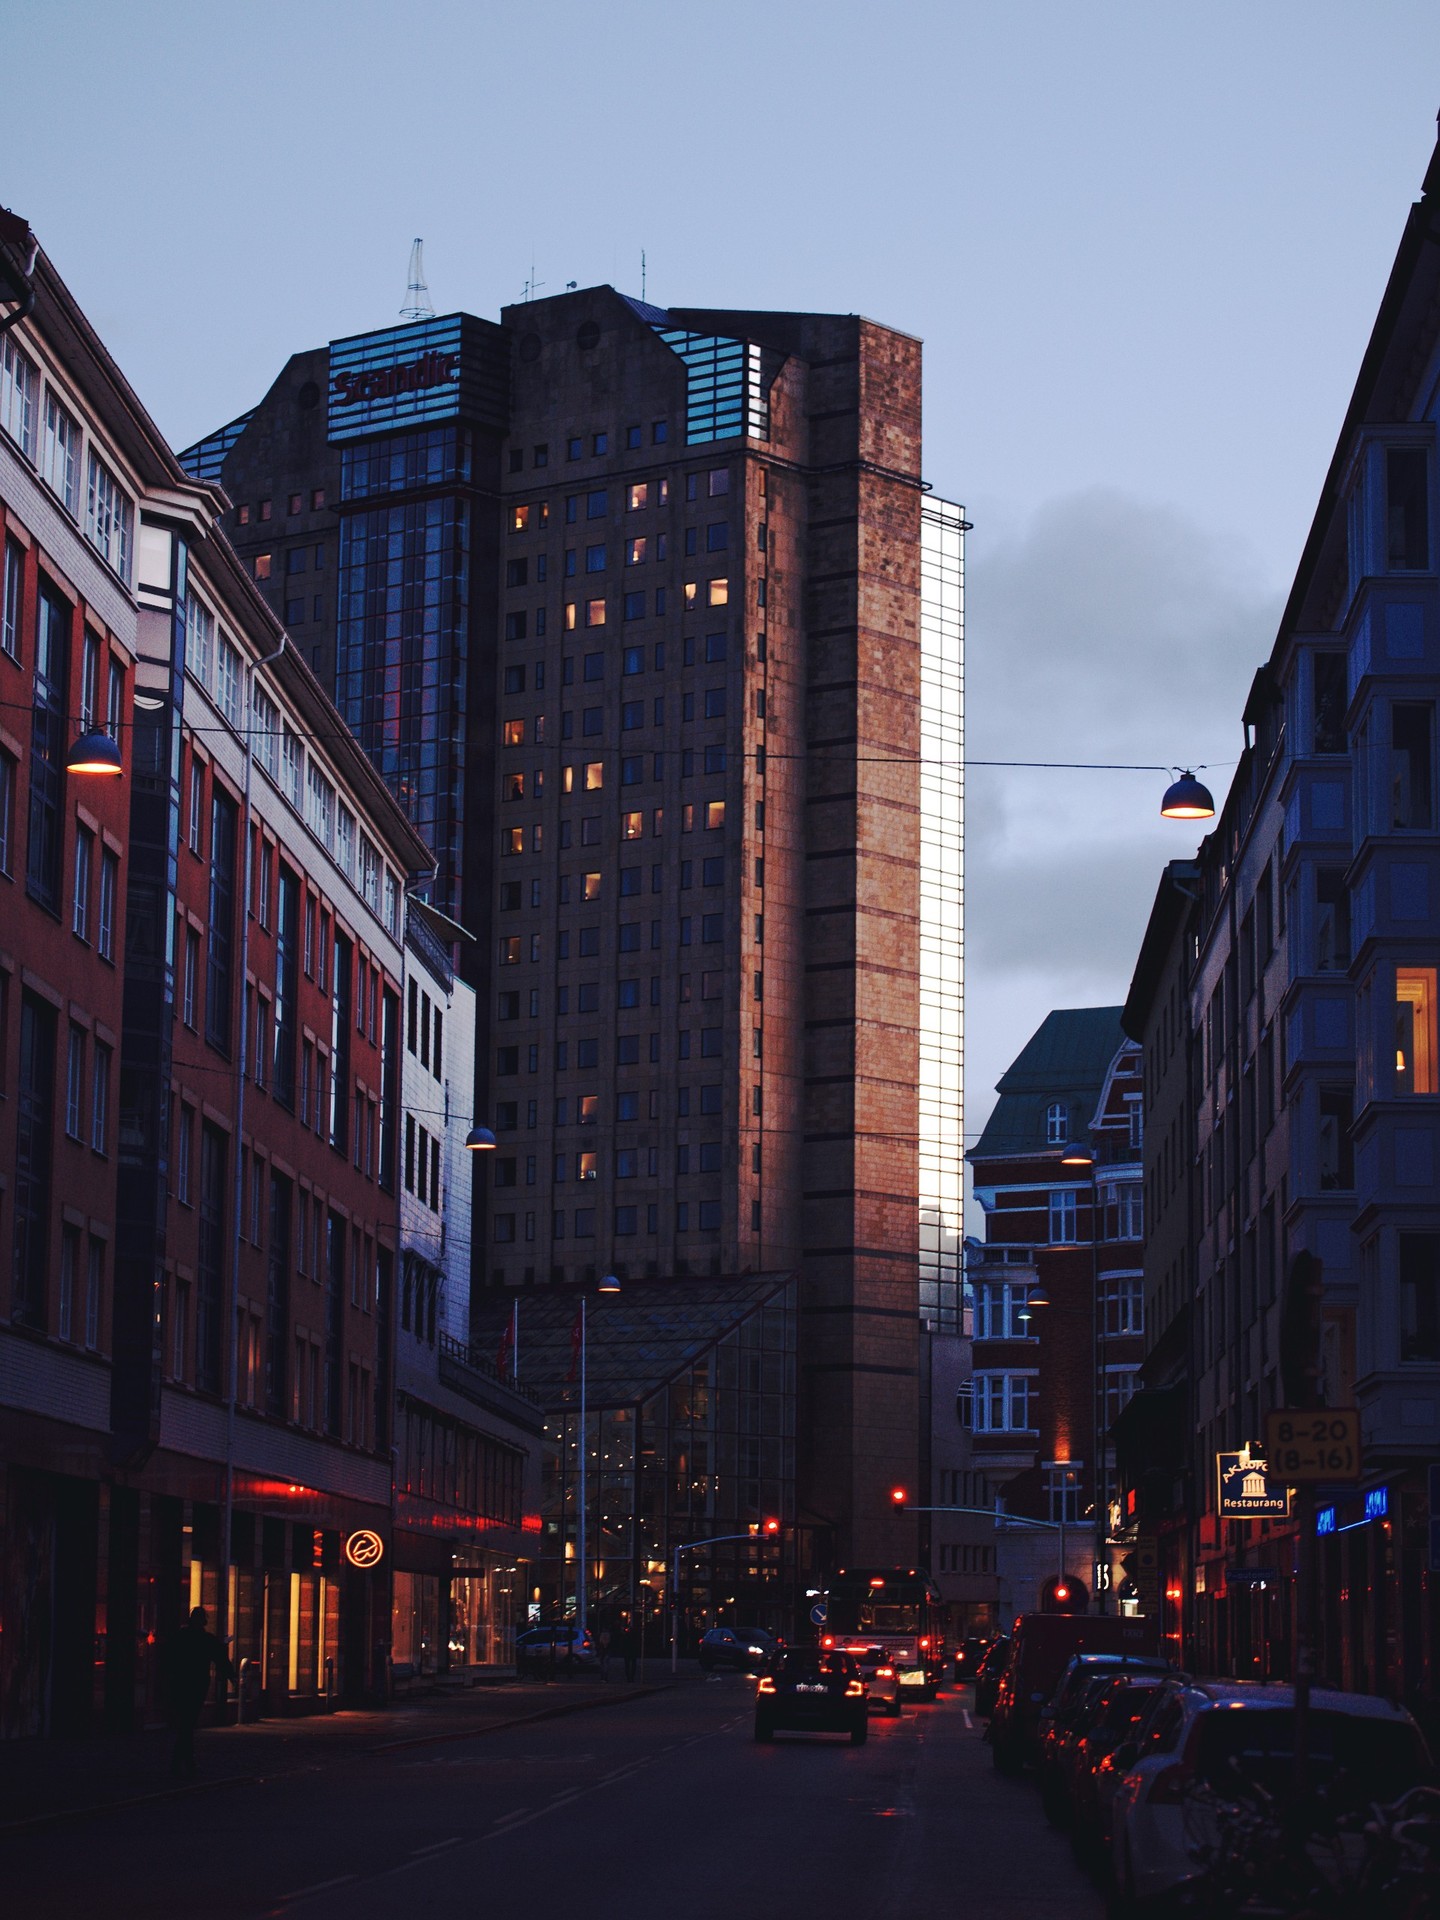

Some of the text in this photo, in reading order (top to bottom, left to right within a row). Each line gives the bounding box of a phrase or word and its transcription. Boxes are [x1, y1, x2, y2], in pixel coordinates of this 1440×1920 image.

[333, 350, 460, 407] Scandic
[1278, 1419, 1347, 1443] 8-20
[1275, 1446, 1352, 1473] (8-16)
[1223, 1498, 1284, 1509] Restaurang
